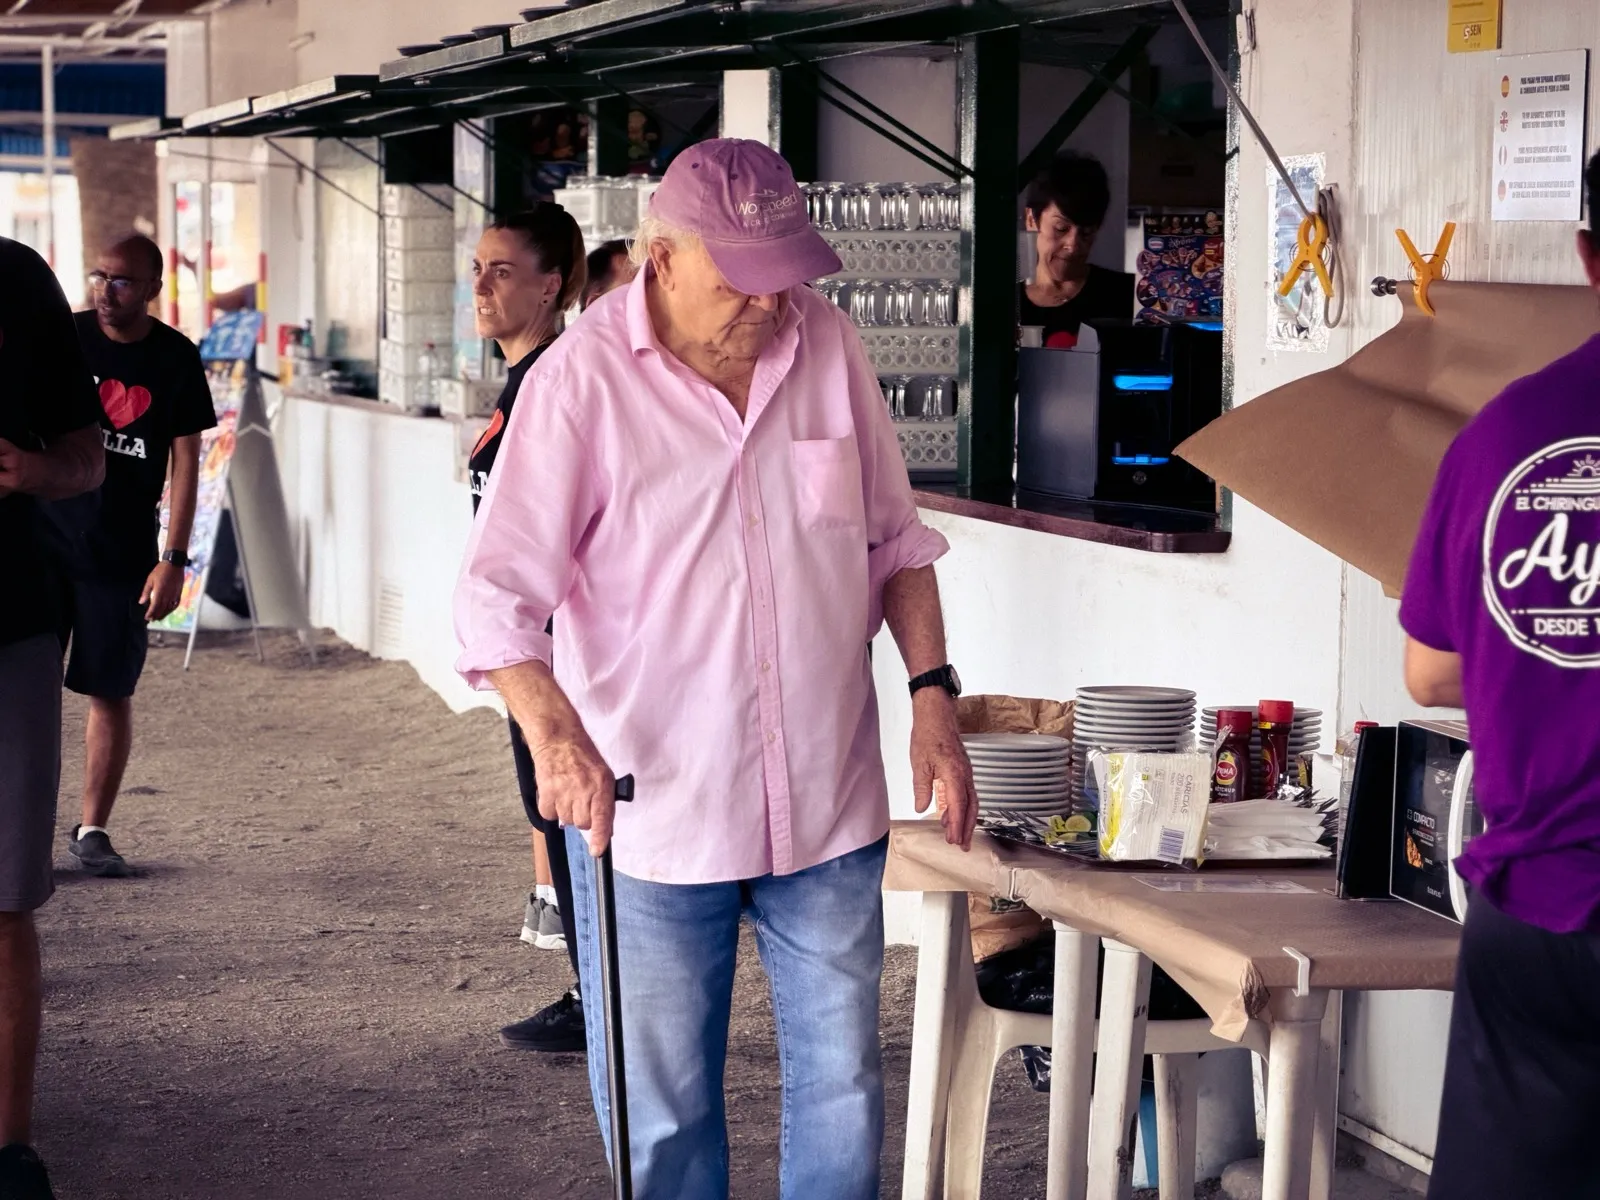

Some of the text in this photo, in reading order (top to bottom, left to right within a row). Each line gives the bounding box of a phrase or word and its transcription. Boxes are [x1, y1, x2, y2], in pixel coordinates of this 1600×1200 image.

[100, 428, 147, 459] LLA
[1515, 496, 1530, 511] EL
[1533, 617, 1589, 636] DESDE
[1180, 774, 1194, 814] CARICIAS
